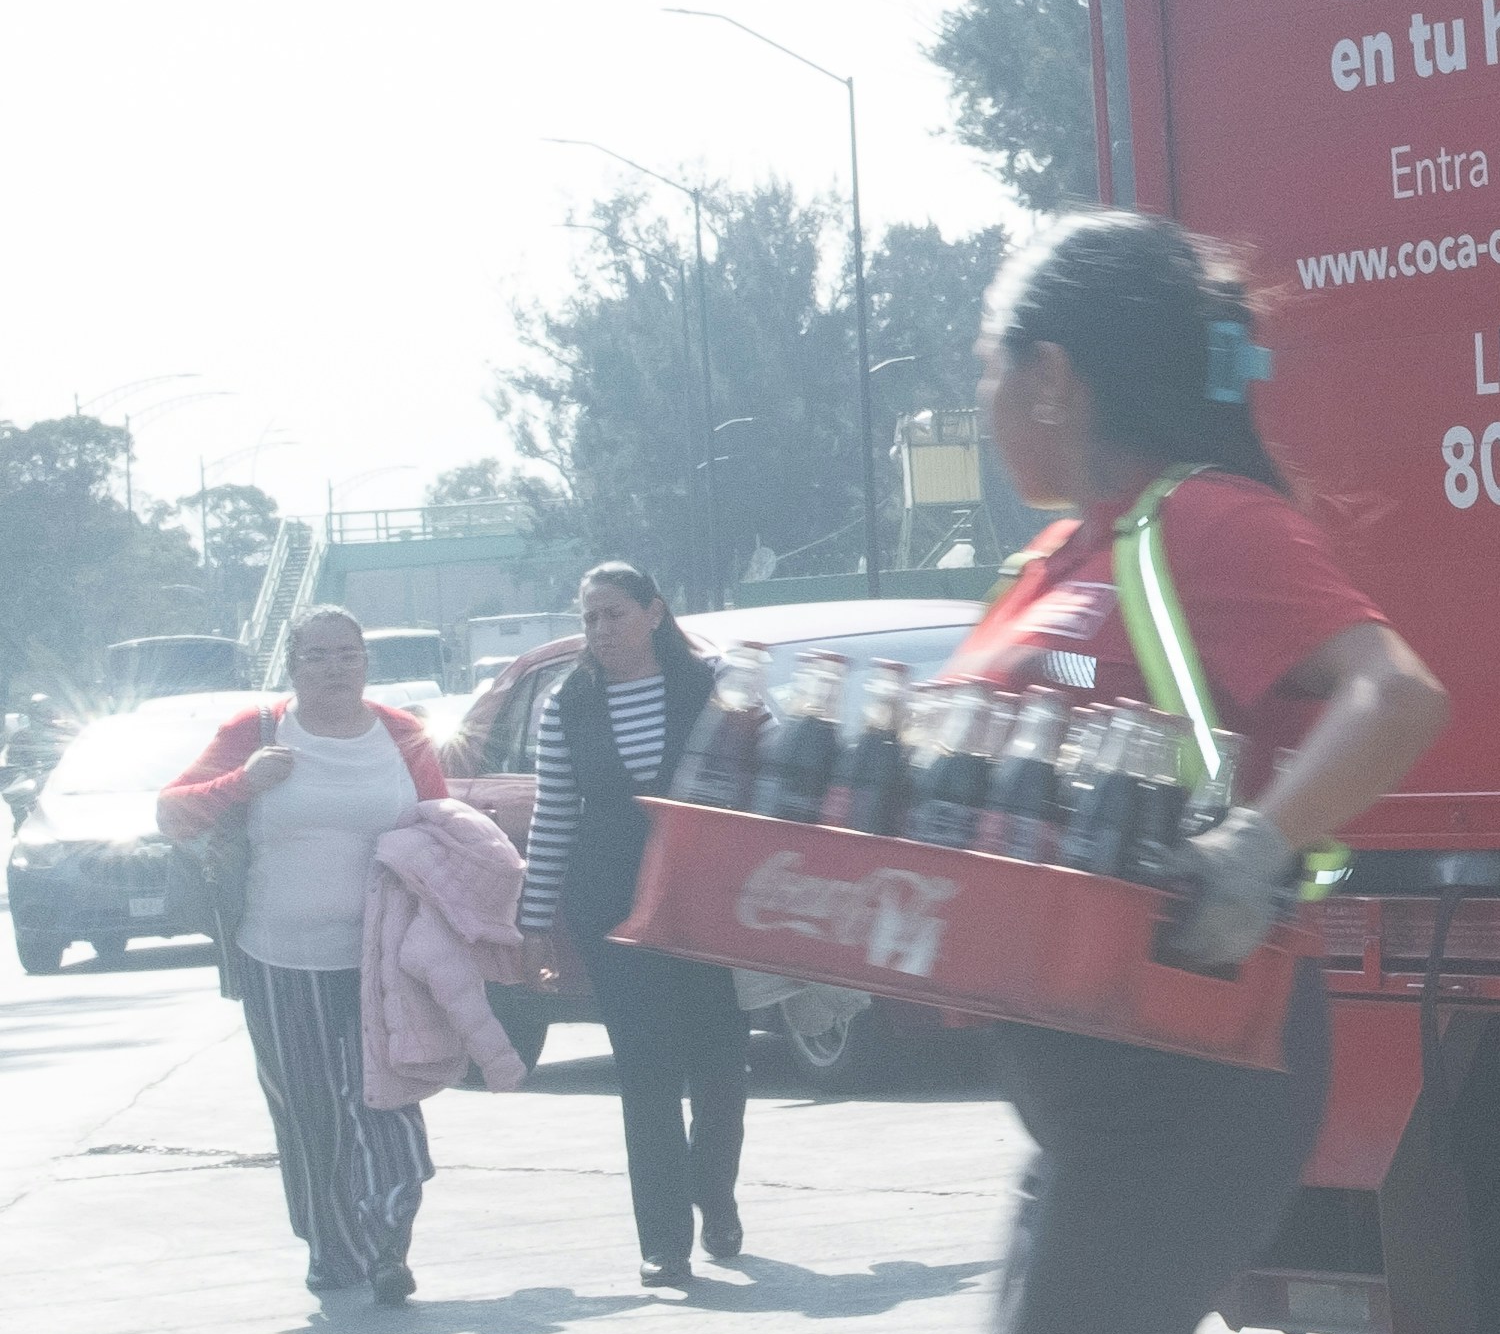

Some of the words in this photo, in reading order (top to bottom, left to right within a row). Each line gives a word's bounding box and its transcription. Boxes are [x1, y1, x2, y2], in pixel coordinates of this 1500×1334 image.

[1331, 27, 1395, 93] en
[1409, 12, 1467, 79] tu
[1389, 143, 1490, 200] Entra
